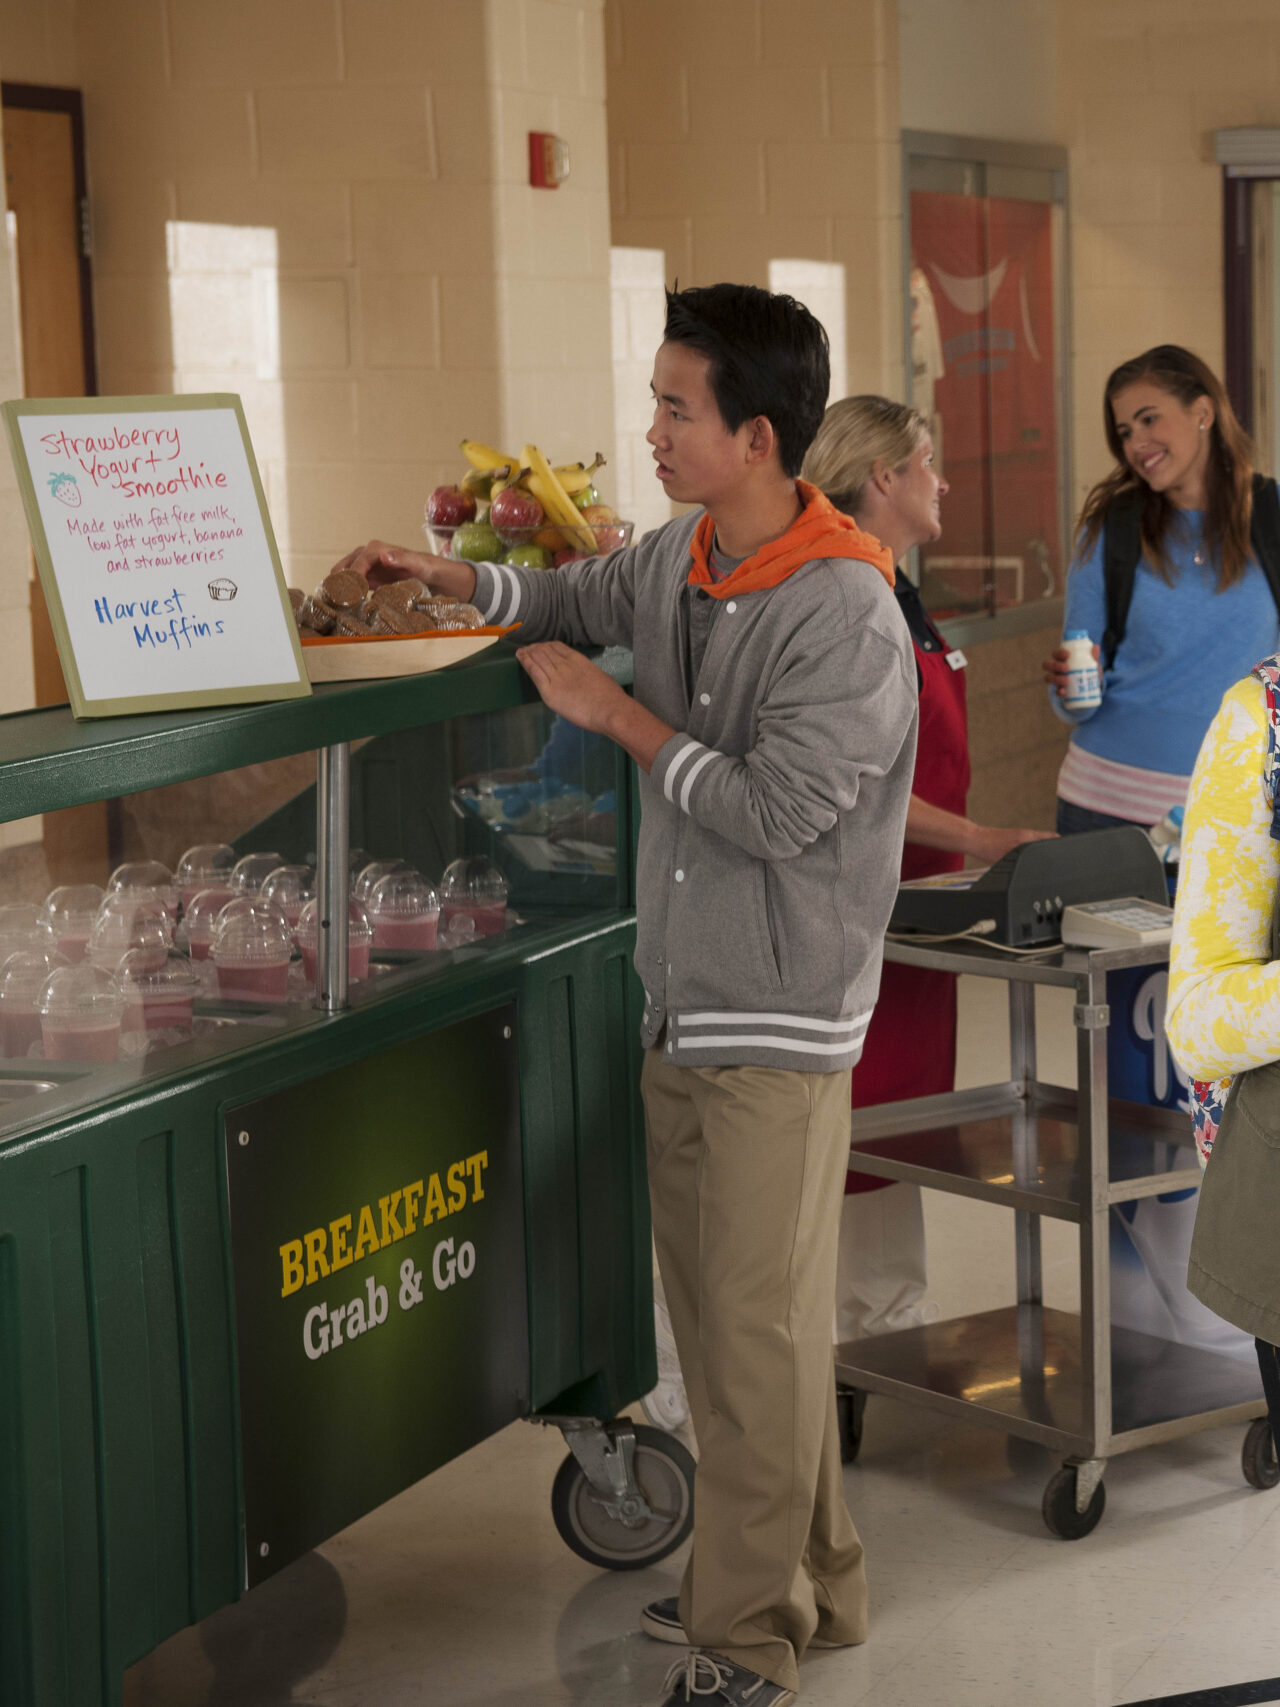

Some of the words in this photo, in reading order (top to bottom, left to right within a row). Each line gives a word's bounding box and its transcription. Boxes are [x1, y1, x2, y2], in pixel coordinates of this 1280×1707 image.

[40, 426, 181, 460] Strawberry
[79, 450, 162, 489] Yogurt
[122, 462, 228, 498] smoothie
[67, 517, 105, 536] Made
[113, 512, 143, 530] with
[148, 507, 170, 533] fat
[171, 505, 196, 529] free
[201, 504, 236, 524] milk,
[87, 535, 111, 552] low
[114, 533, 138, 555] fat
[141, 530, 192, 551] yogurt,
[193, 526, 244, 543] banana
[106, 557, 130, 574] and
[134, 548, 225, 570] strawberries
[95, 588, 186, 624] Harvest
[133, 615, 225, 650] Muffins
[279, 1149, 489, 1299] BREAKFAST
[303, 1274, 389, 1361] Grab
[398, 1257, 424, 1311] &
[432, 1236, 476, 1291] Go
